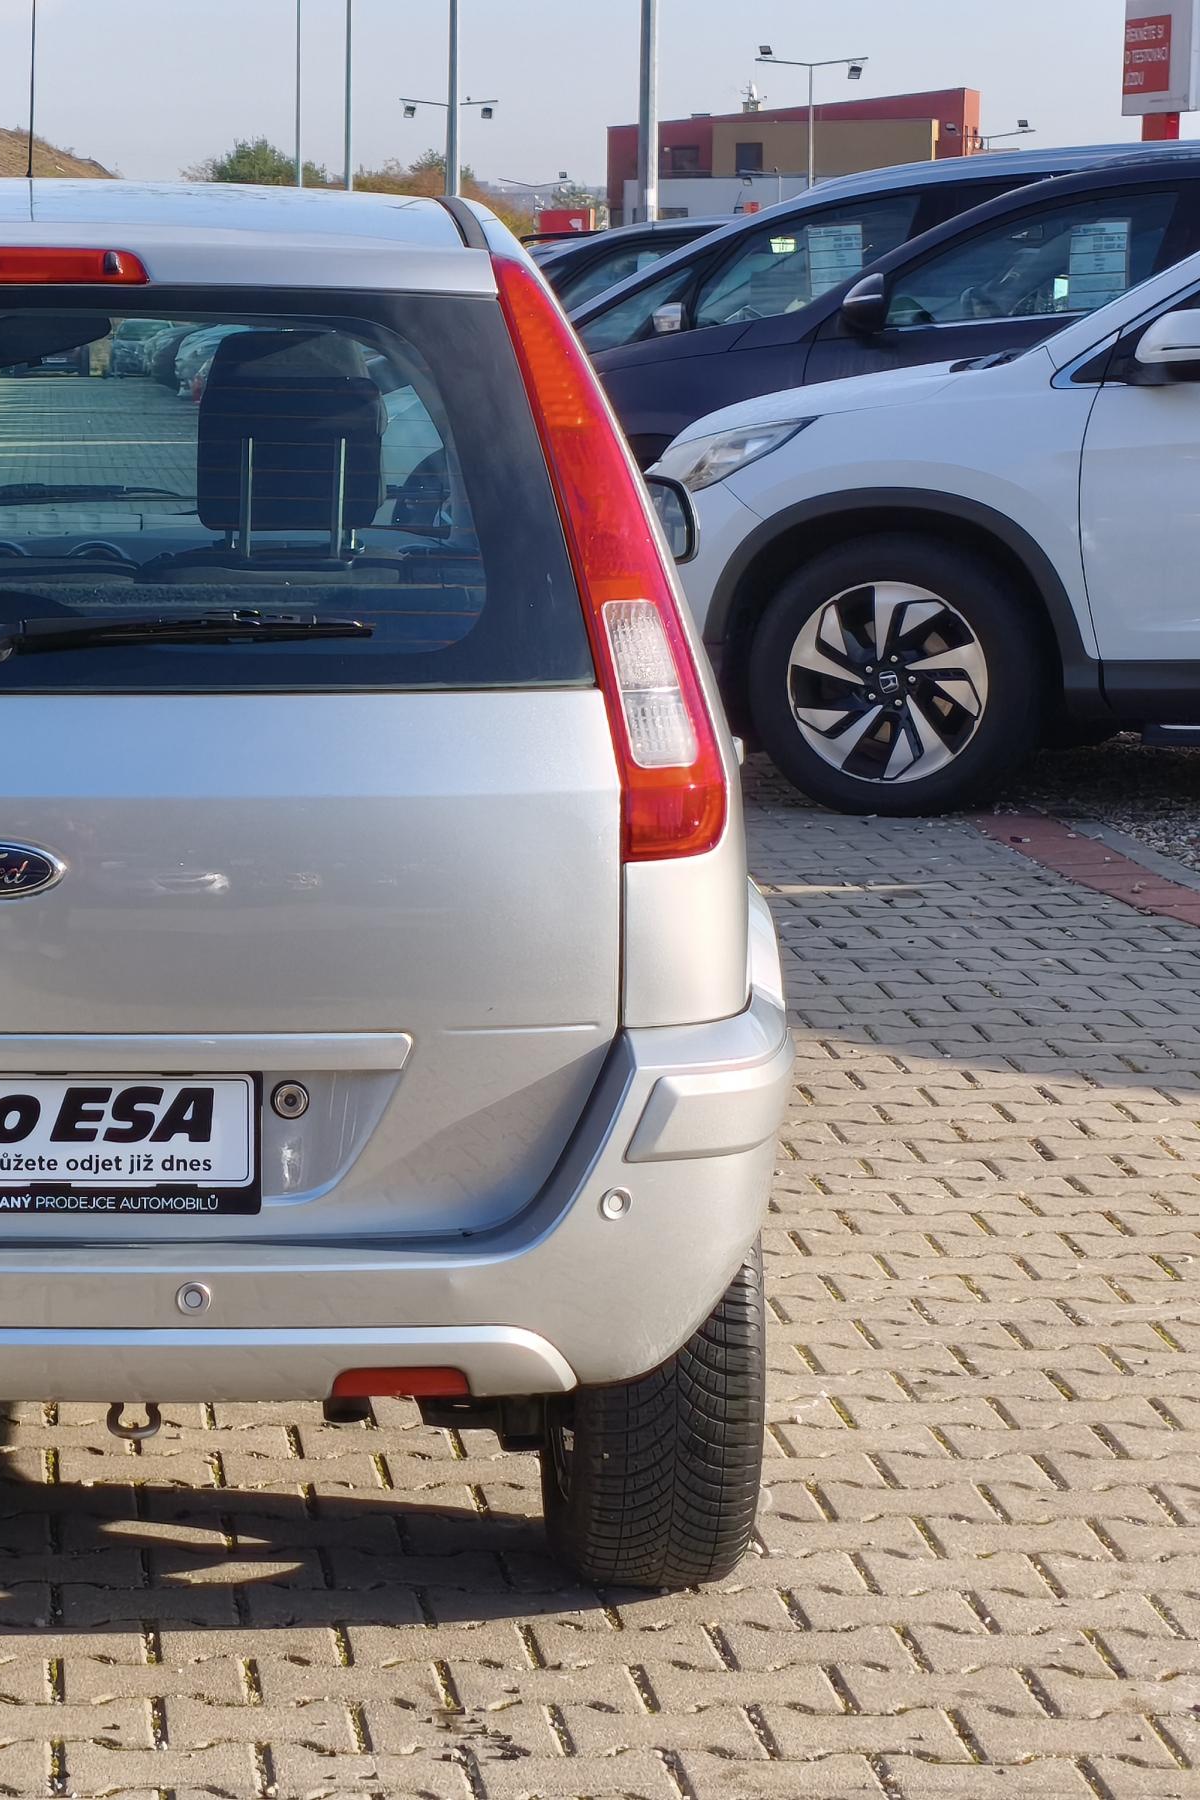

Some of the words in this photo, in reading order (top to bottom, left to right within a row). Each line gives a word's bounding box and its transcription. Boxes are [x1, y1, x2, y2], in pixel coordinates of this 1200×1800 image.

[49, 1086, 214, 1143] ESA
[66, 1155, 123, 1175] odjet
[128, 1154, 154, 1175] již
[161, 1155, 212, 1171] dnes
[35, 1196, 116, 1210] PRODEJCE
[119, 1194, 219, 1210] AUTOMOBILŮ
